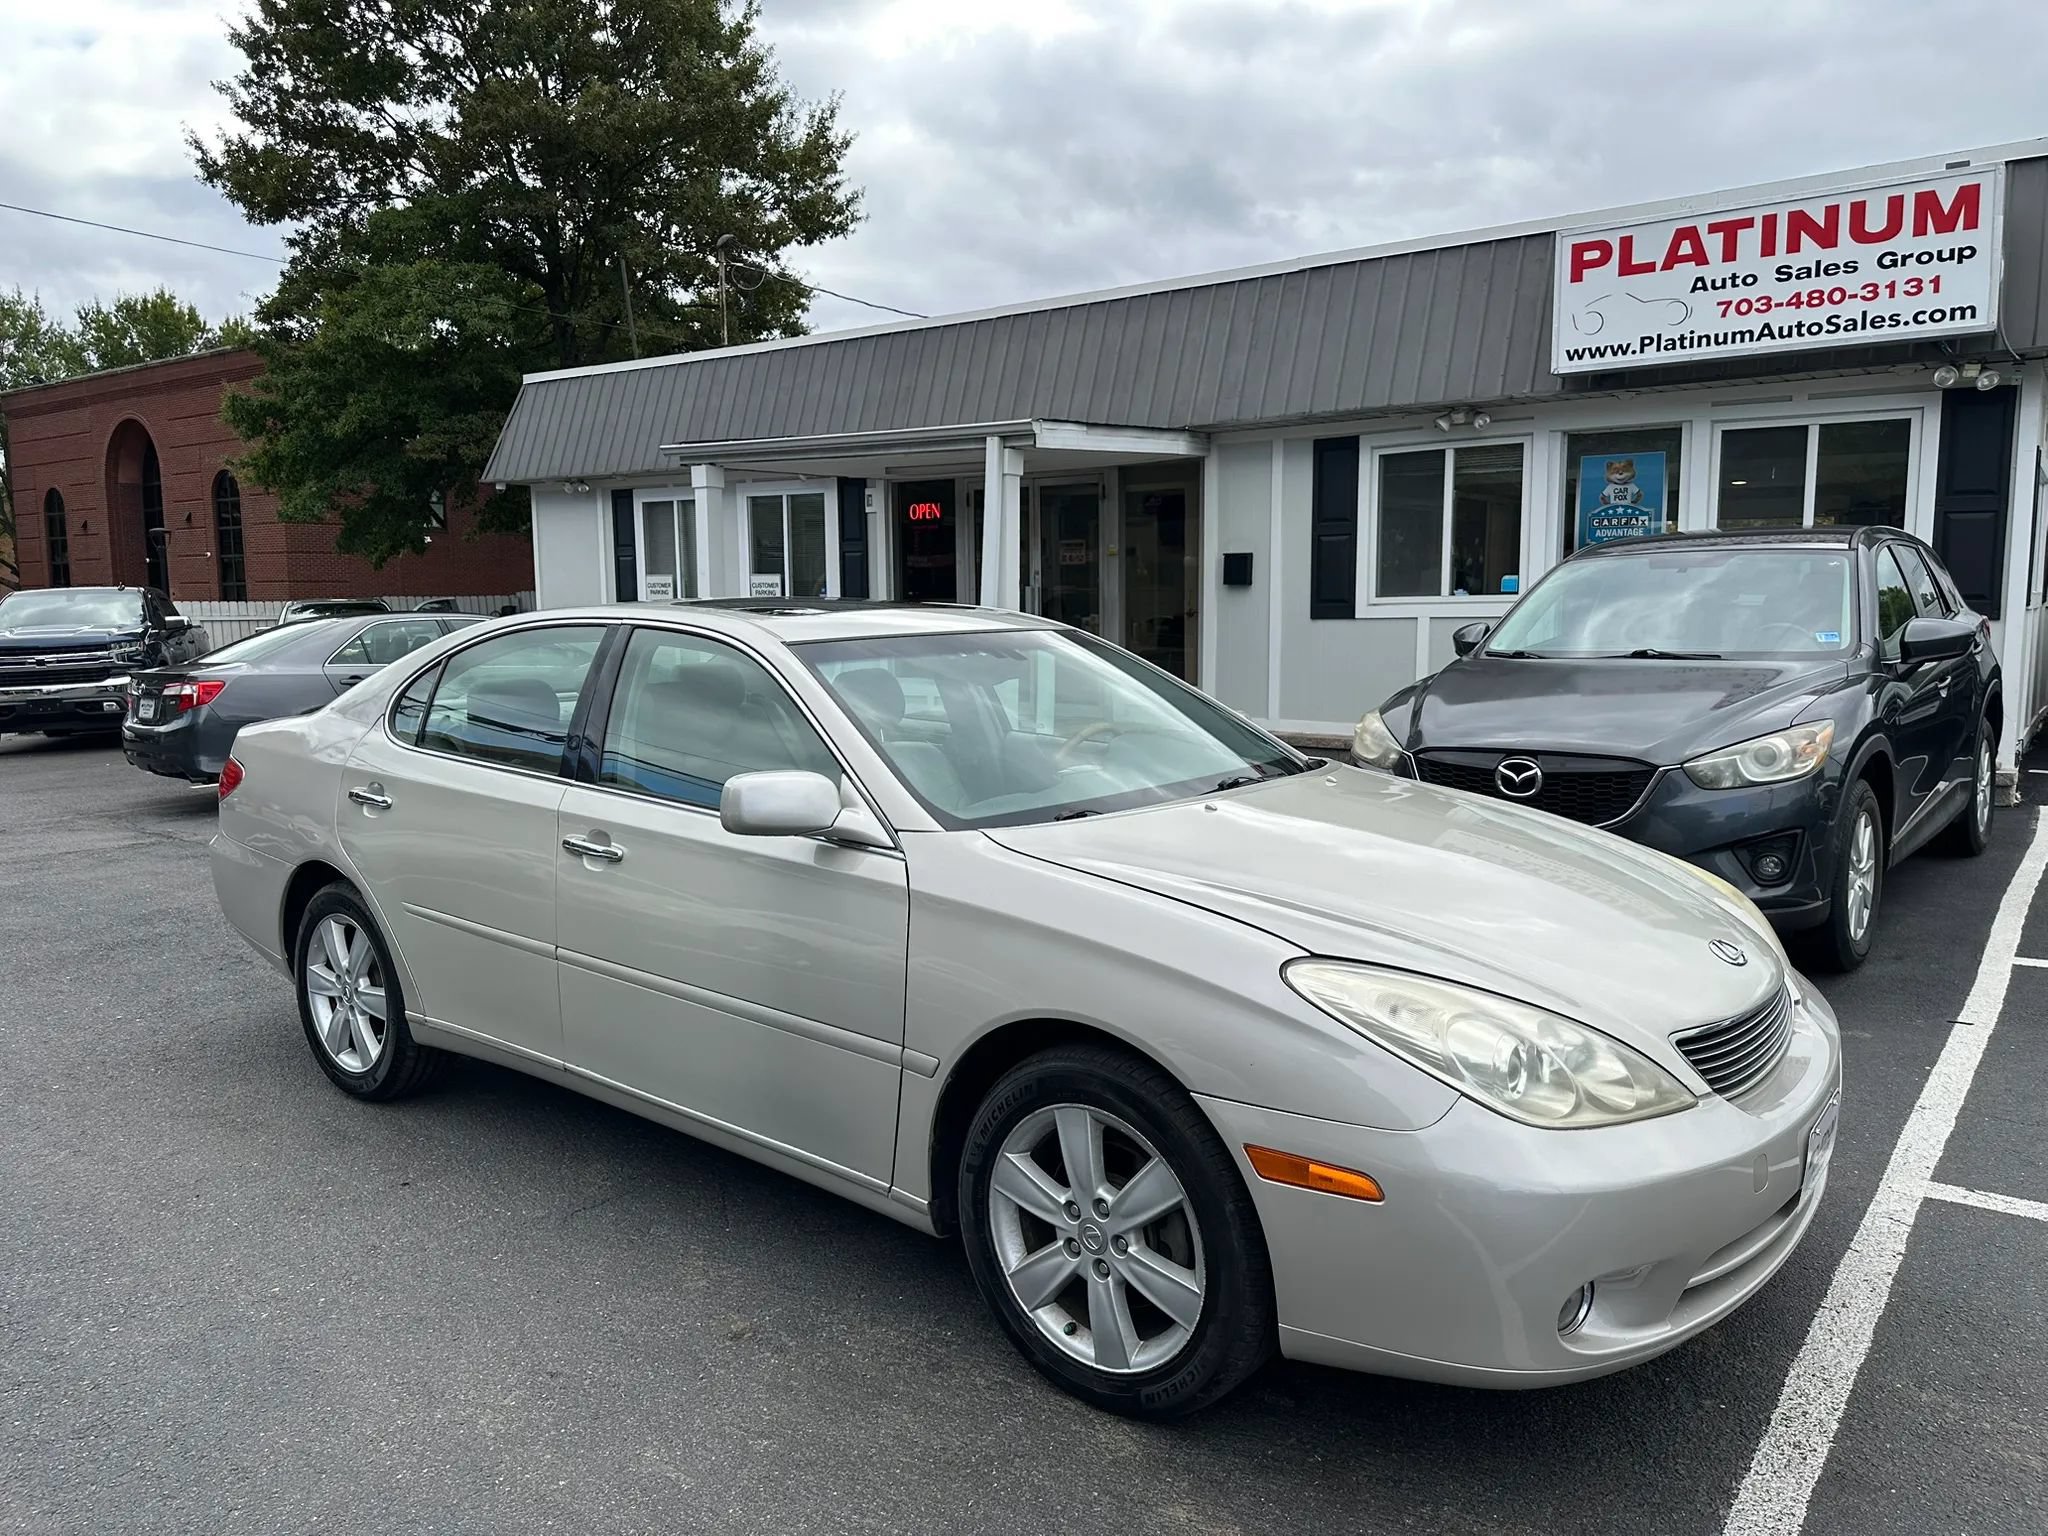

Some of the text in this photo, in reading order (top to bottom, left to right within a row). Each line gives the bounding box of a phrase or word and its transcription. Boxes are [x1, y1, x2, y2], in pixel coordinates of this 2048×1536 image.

[1570, 183, 1981, 284] PLATINUM
[1690, 245, 1977, 294] Auto Sales Group
[1716, 274, 1942, 319] 703-480-3131
[1565, 304, 1977, 362] www.PlatinumAutoSales.com
[909, 502, 941, 520] OPEN
[1592, 516, 1648, 526] CARFAX
[1595, 528, 1644, 537] ADVANTAGE
[649, 588, 670, 596] PARKING
[754, 588, 777, 596] PARKING
